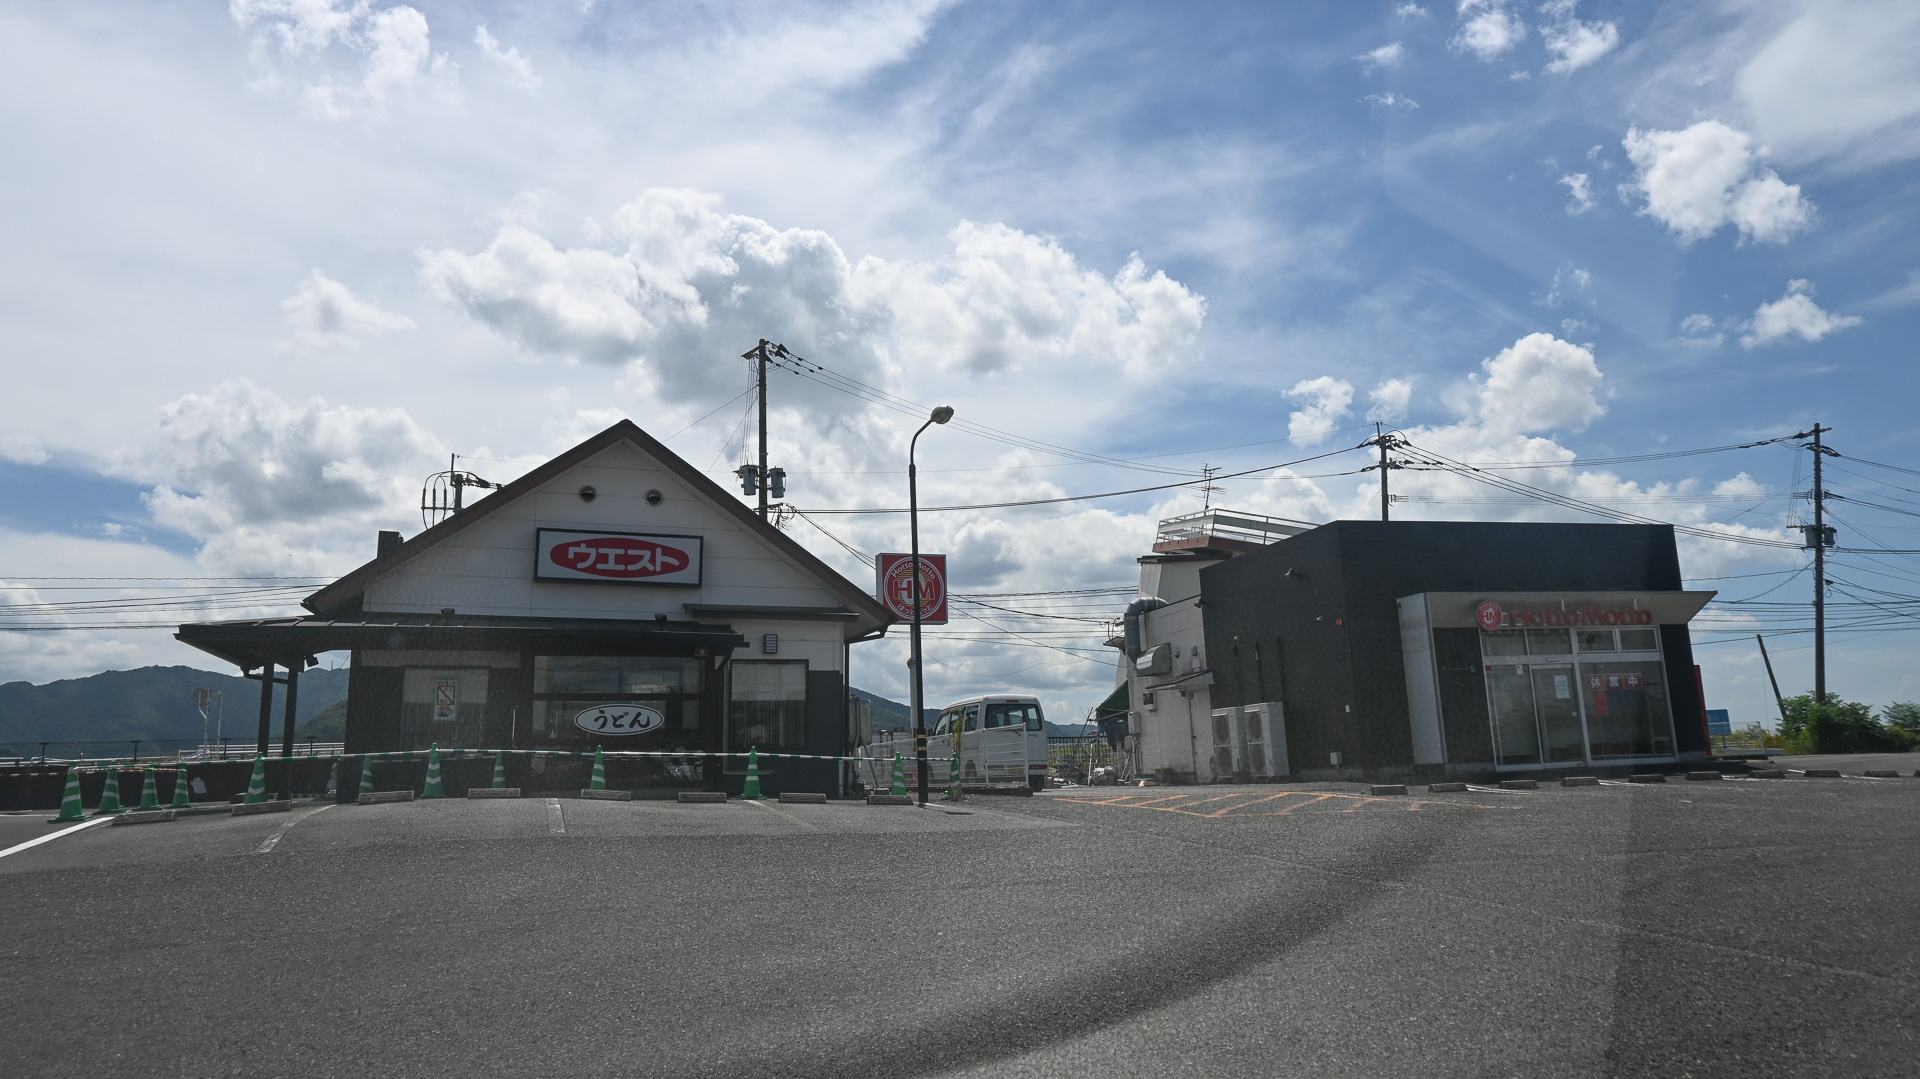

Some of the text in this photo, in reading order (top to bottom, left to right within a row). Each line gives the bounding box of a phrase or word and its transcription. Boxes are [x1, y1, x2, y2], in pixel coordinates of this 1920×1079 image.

[568, 543, 680, 572] ウエスト
[897, 603, 933, 616] ほっとっと
[1590, 675, 1638, 689] 休業中
[593, 709, 651, 730] うどん
